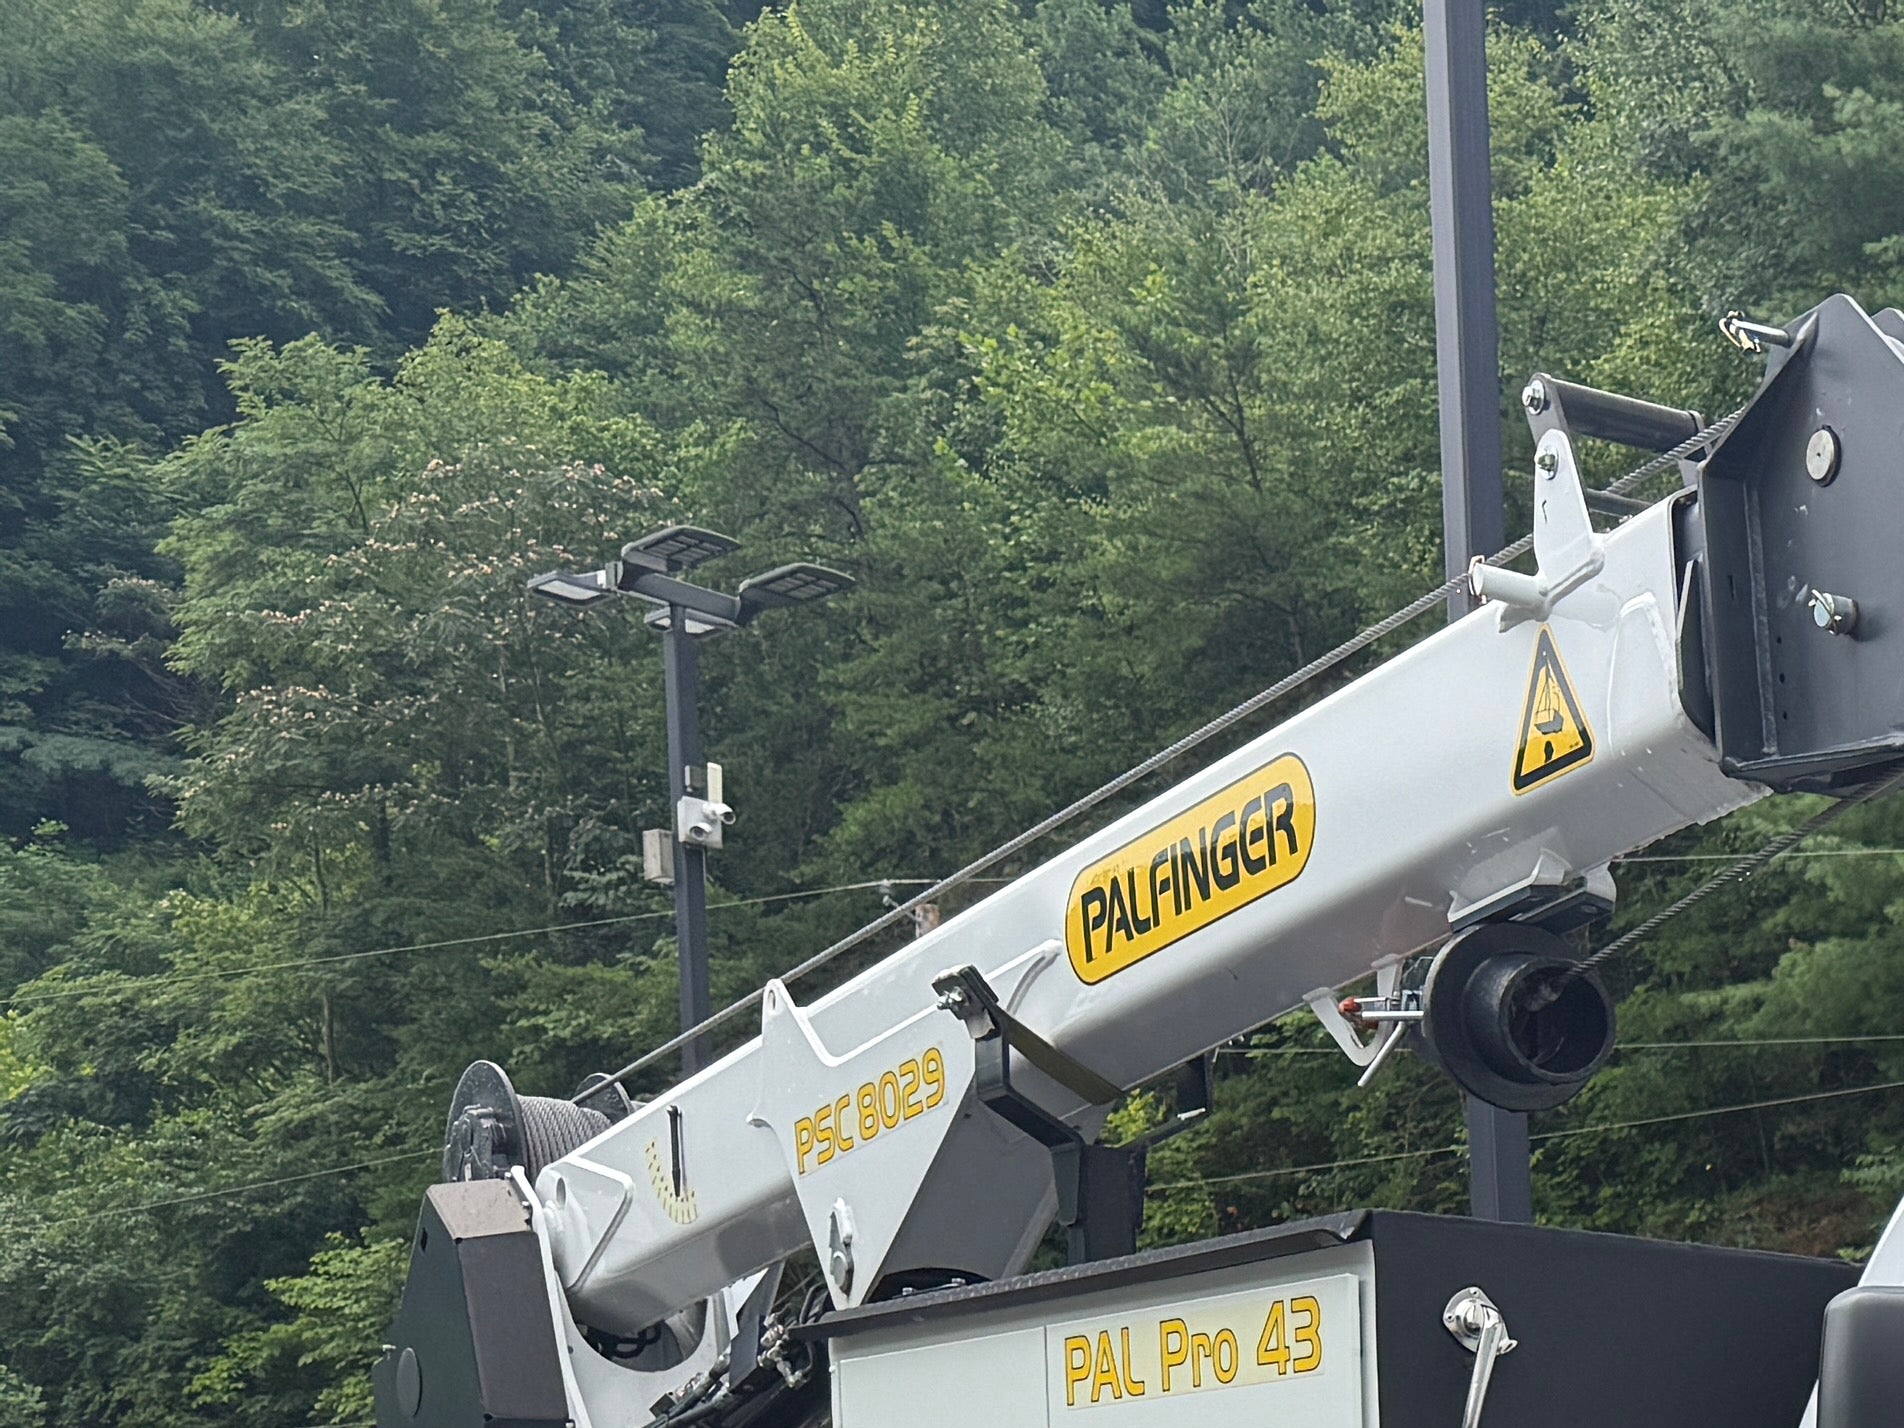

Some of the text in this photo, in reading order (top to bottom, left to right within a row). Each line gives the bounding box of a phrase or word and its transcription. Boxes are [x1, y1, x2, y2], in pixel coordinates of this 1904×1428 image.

[1081, 782, 1299, 964] PALFINGER
[794, 1047, 945, 1175] PSC 8029
[1064, 1295, 1322, 1406] PAL Pro 43
